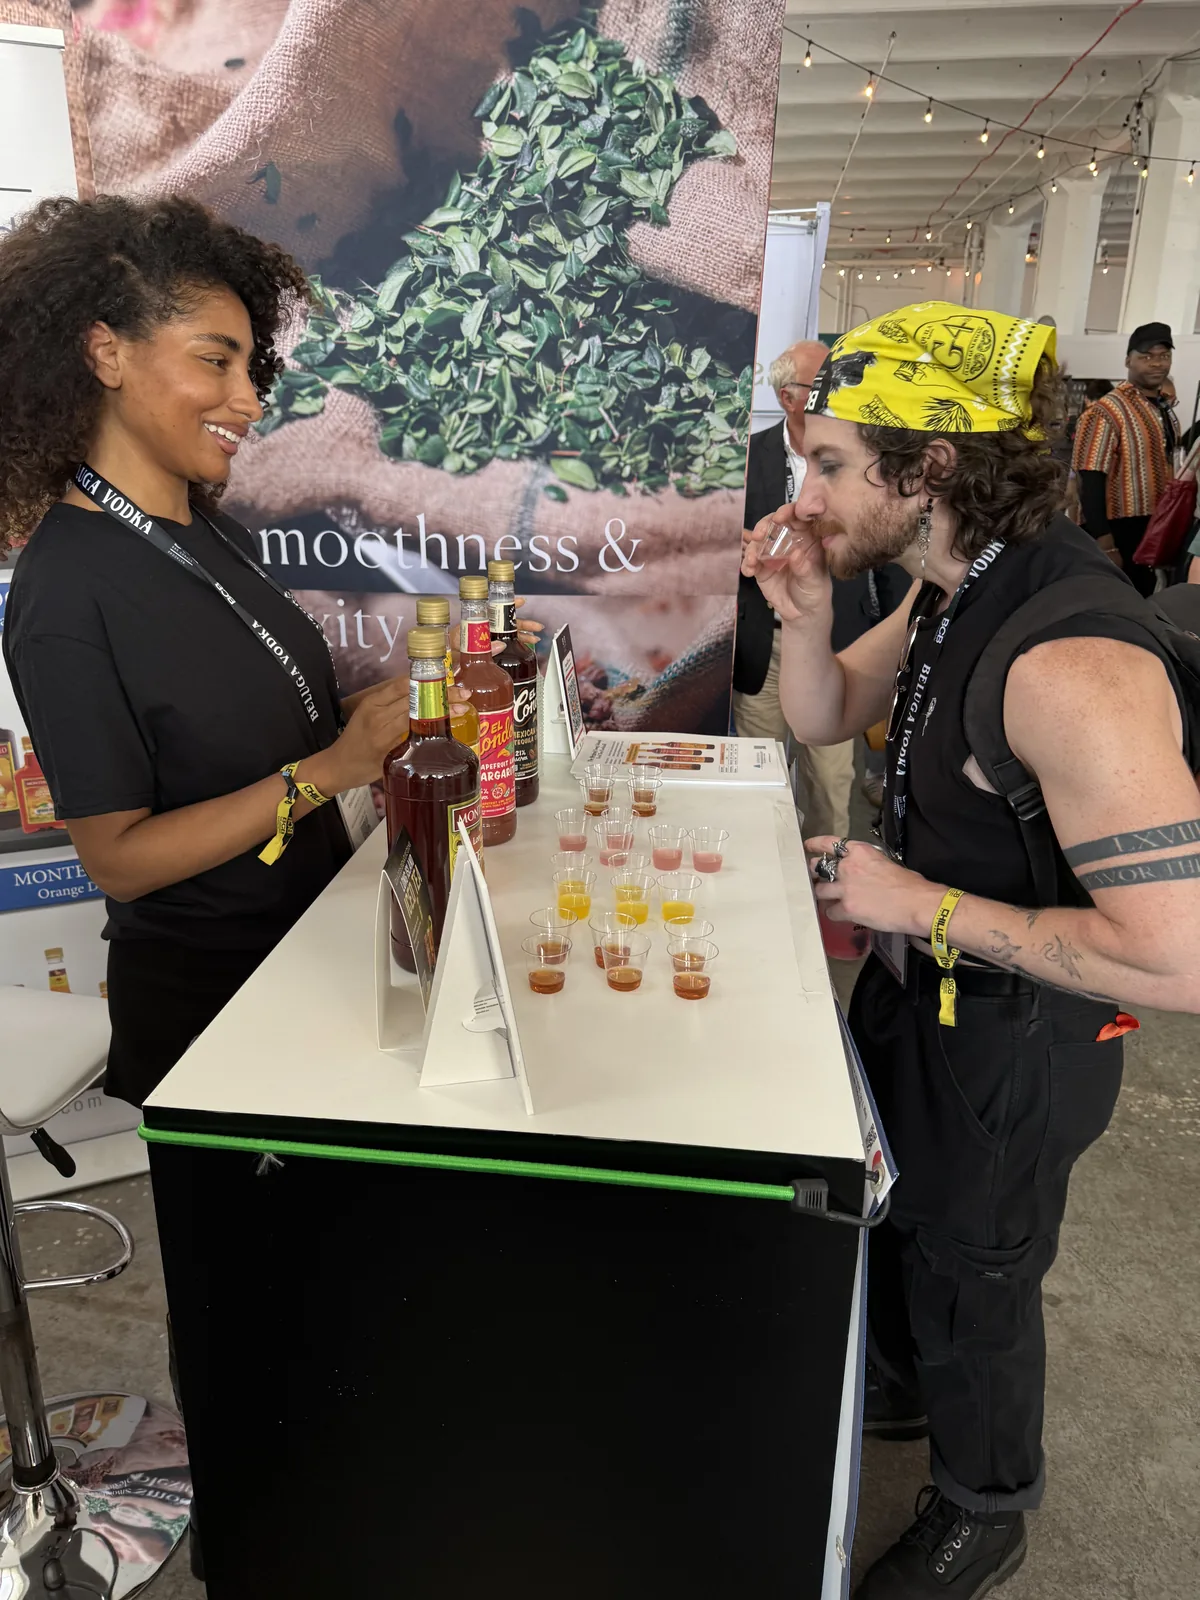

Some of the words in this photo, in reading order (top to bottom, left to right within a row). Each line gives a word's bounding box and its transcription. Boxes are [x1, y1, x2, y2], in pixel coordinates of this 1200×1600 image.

[101, 488, 153, 535] VODKA
[258, 512, 580, 573] moothness
[598, 517, 645, 573] &
[968, 538, 1007, 580] VODK
[214, 581, 237, 605] BCB
[251, 619, 290, 666] VODKA
[935, 617, 950, 644] BCB
[290, 665, 319, 723] BELUGA
[907, 663, 931, 724] BELUGA
[490, 720, 504, 734] EL
[896, 728, 913, 776] VODKA
[37, 884, 85, 900] Orange
[935, 908, 950, 944] CHILLED
